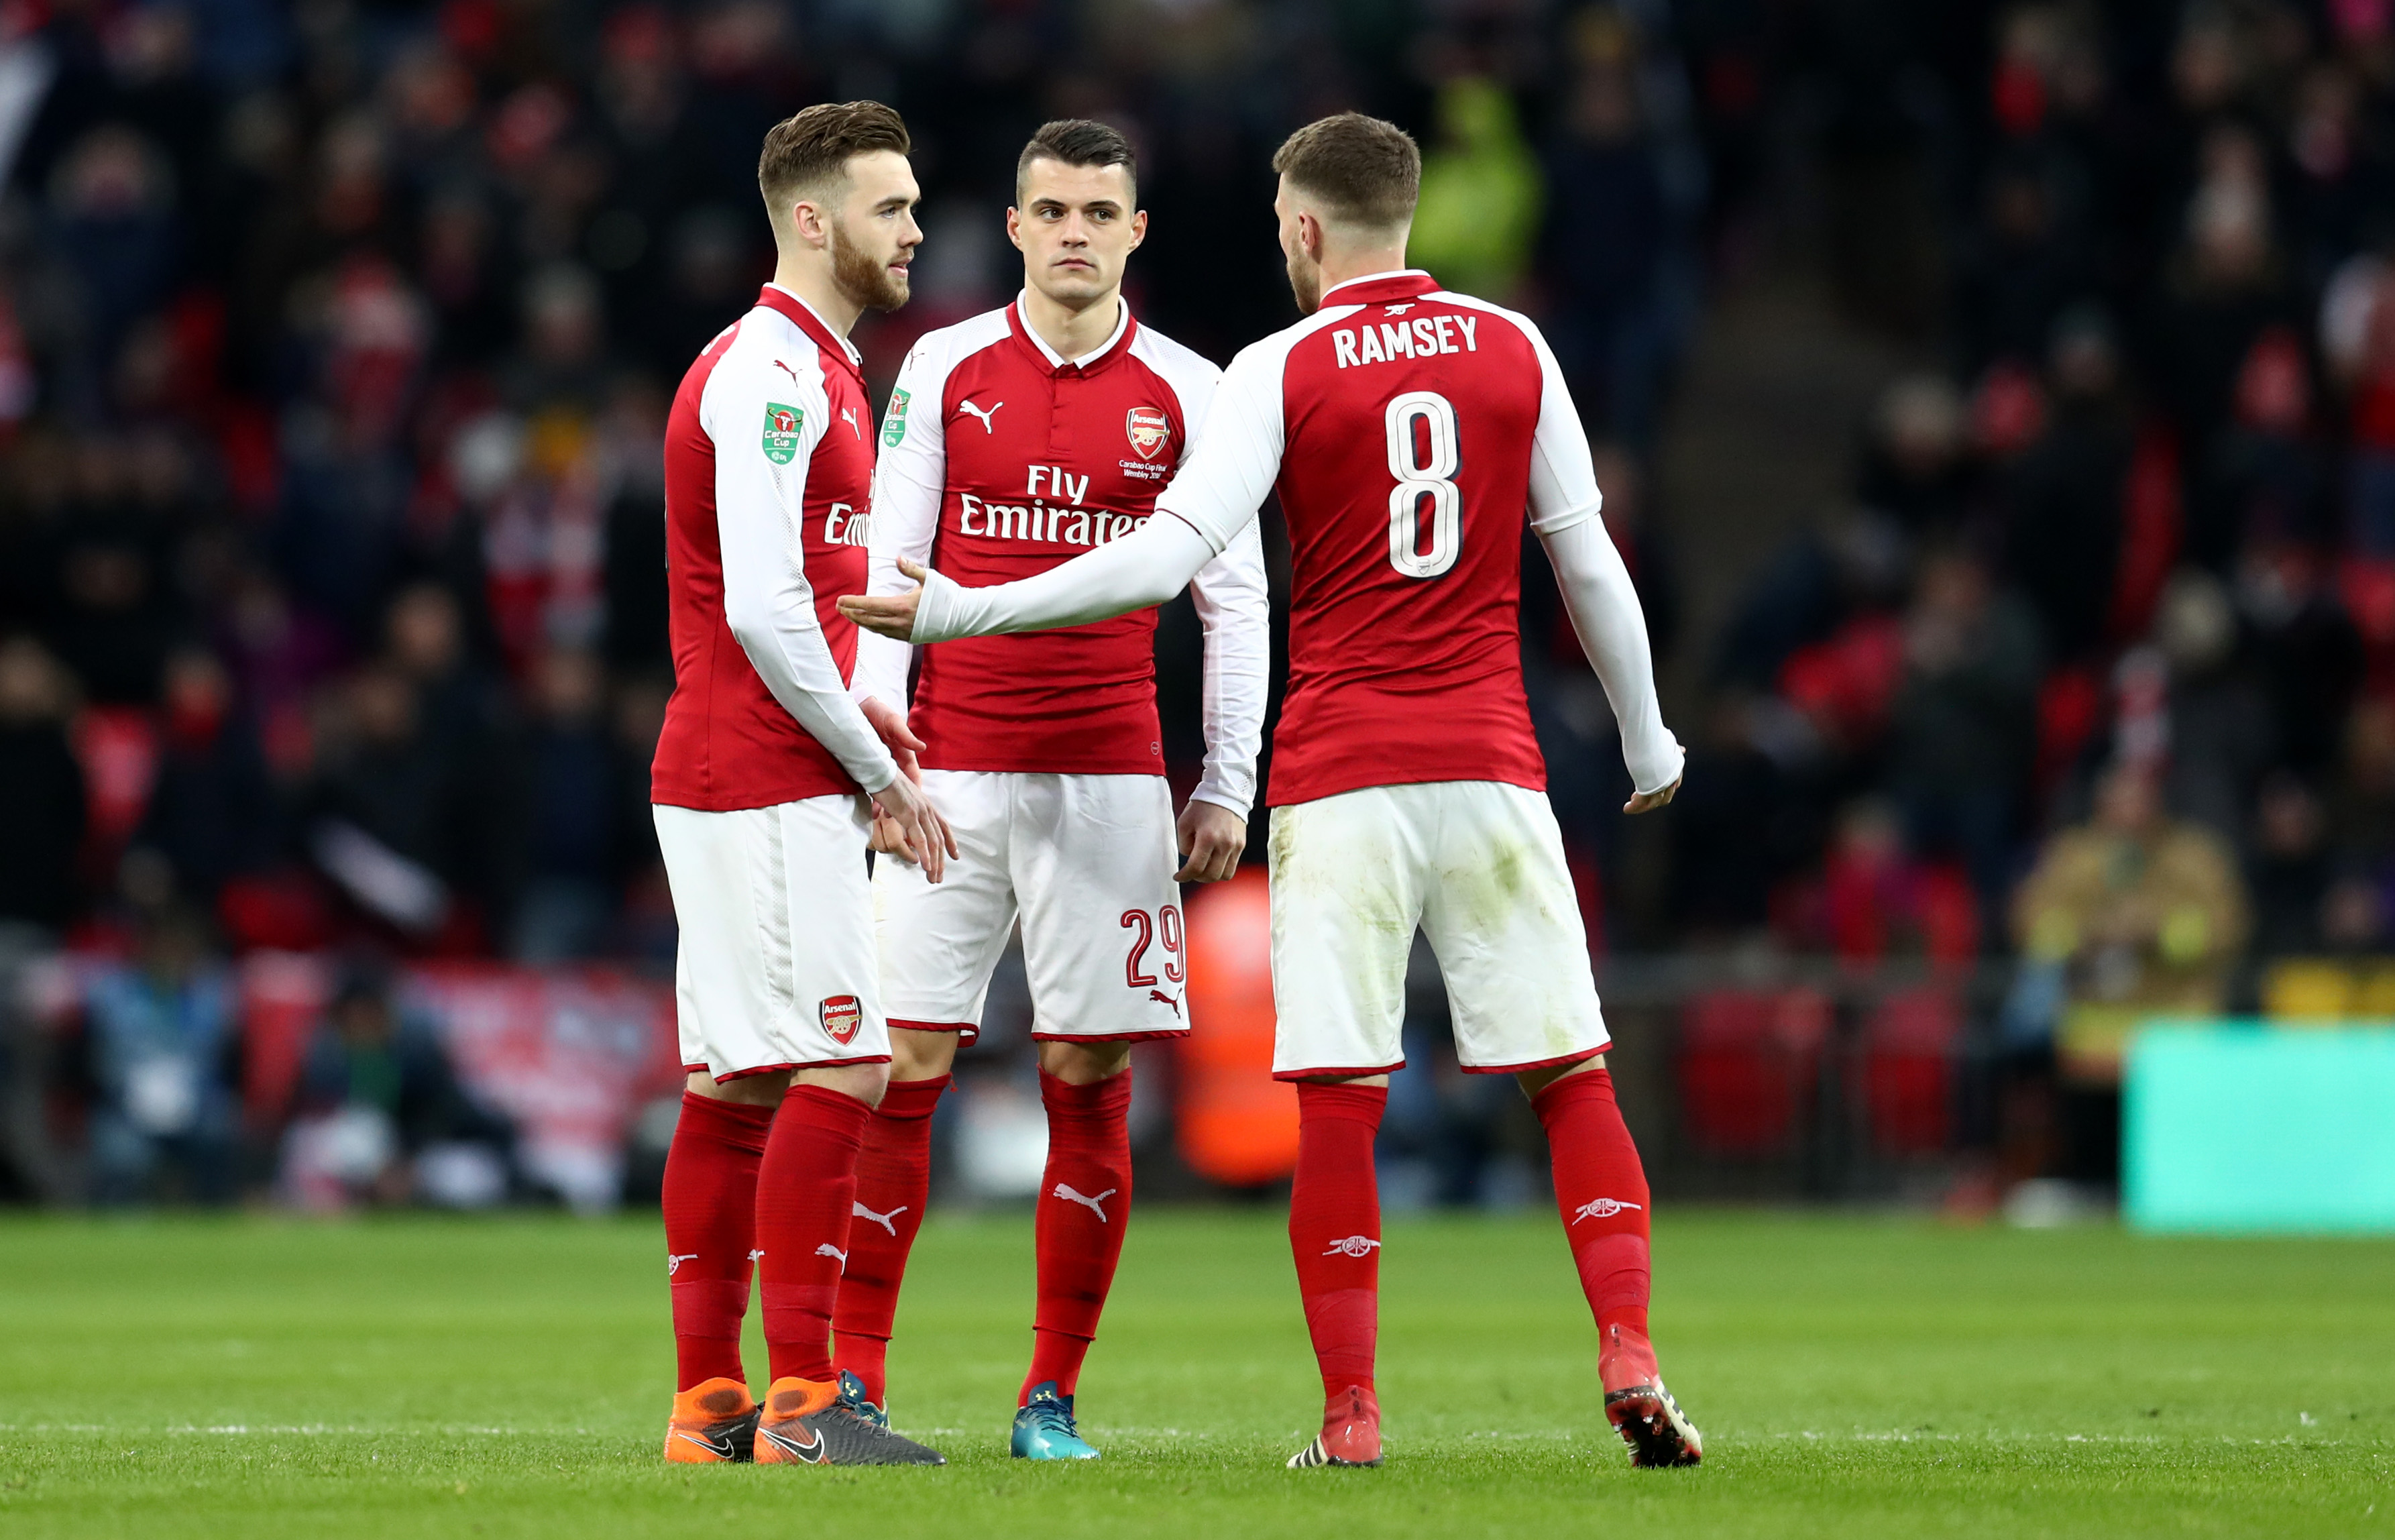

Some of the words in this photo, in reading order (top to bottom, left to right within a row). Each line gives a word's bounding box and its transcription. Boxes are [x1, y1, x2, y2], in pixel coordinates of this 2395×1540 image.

[1332, 315, 1477, 369] RAMSEY
[1133, 415, 1163, 425] Arsenal
[764, 429, 799, 439] Carabao
[773, 437, 790, 447] Cup
[1119, 460, 1144, 470] Carabao
[1145, 463, 1155, 472] Cup
[1124, 470, 1149, 480] Wembley
[1027, 465, 1089, 506] Fly
[1385, 390, 1463, 581] 8
[1120, 904, 1184, 988] 29
[824, 1001, 856, 1014] Arsenal
